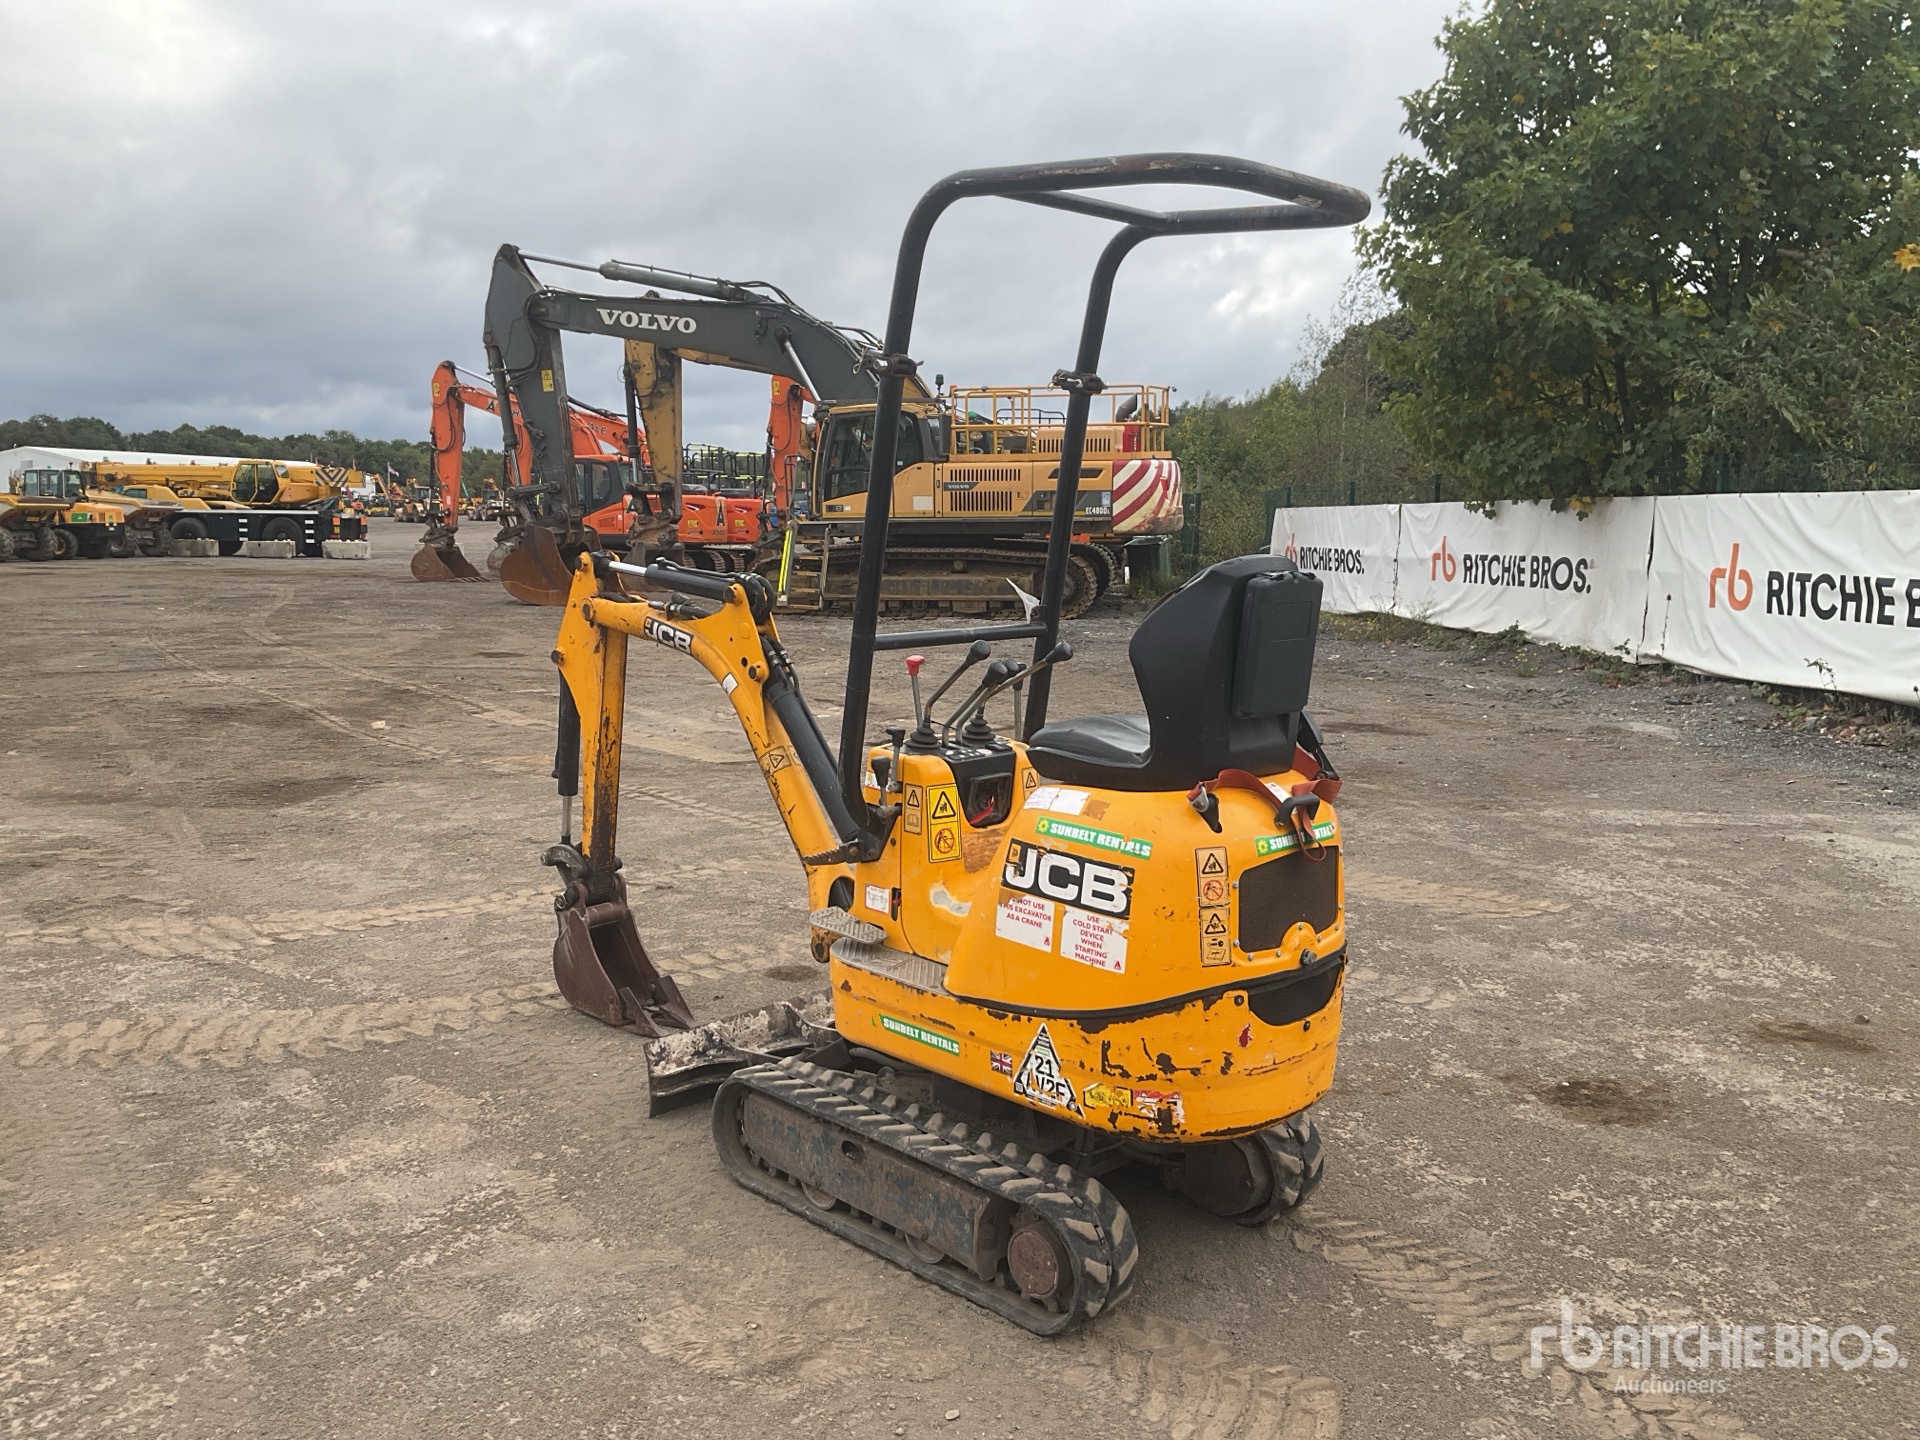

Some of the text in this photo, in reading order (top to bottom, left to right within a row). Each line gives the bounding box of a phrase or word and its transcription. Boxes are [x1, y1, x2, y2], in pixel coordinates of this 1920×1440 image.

[596, 308, 697, 334] VOLVO
[1300, 546, 1332, 571] RITCHIE
[1334, 548, 1364, 575] BROS.
[1463, 554, 1526, 587] RITCHIE
[1529, 555, 1591, 594] BROS.
[1766, 570, 1896, 626] RITCHIE
[644, 621, 691, 654] JCB
[1050, 823, 1152, 857] SUNBELT RENTALS
[1006, 848, 1128, 913] JCB
[1014, 906, 1052, 922] EXCAVATOR
[1018, 898, 1031, 906] NOT
[1033, 902, 1045, 911] USE
[1006, 912, 1015, 920] AS
[1021, 917, 1043, 928] CRANE
[1072, 919, 1114, 935] COLD START
[1087, 915, 1100, 924] USE
[1080, 929, 1104, 941] DEVICE
[1081, 937, 1102, 949] WHEN
[1074, 944, 1107, 959] STARTING
[1074, 952, 1106, 967] MACHINE
[883, 1017, 959, 1054] SUNBELT RENTALS
[1035, 1055, 1054, 1078] 21
